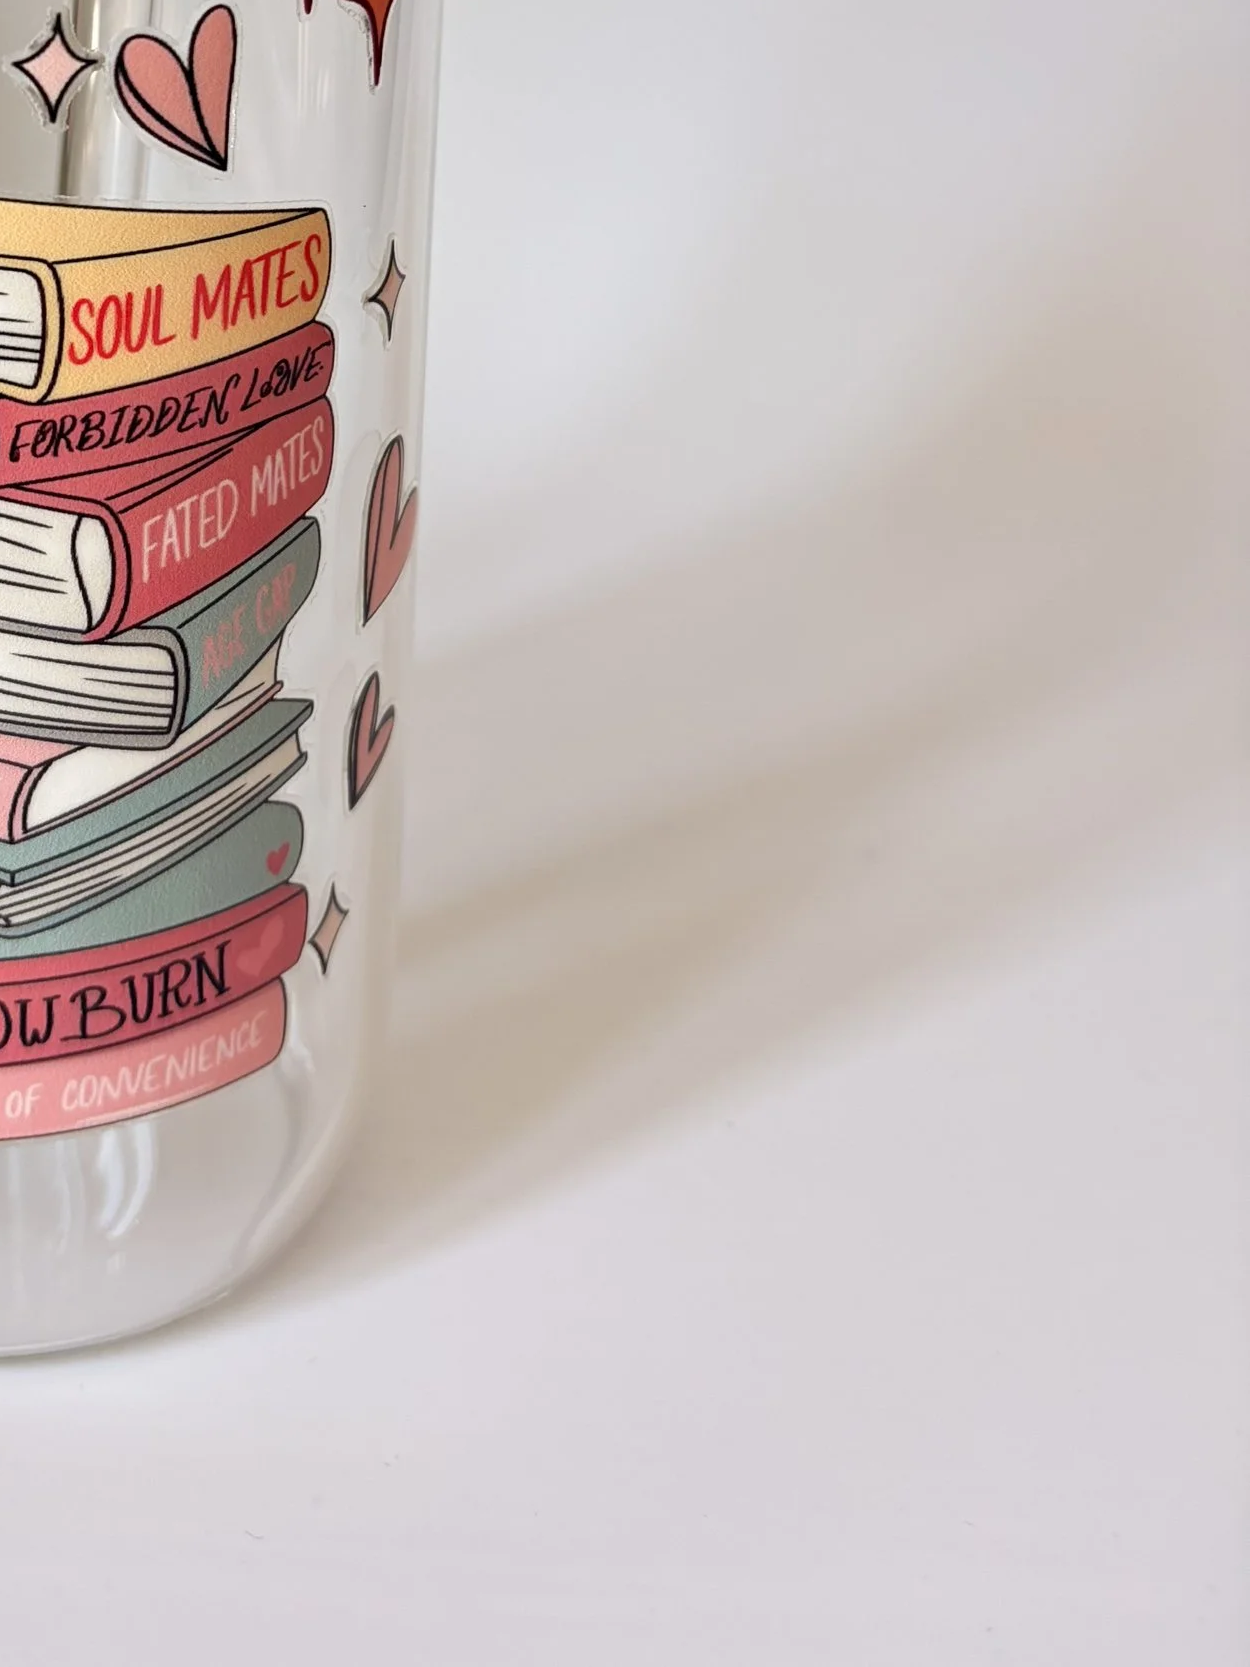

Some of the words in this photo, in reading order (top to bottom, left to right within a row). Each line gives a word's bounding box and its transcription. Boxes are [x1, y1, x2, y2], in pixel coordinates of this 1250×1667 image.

[67, 283, 177, 365] SOUL
[190, 233, 322, 339] MATES
[9, 371, 240, 463] FORBIDDEN
[141, 478, 240, 584] FATED
[251, 415, 325, 516] MATES
[60, 940, 232, 1042] BURN
[4, 1082, 41, 1119] OF
[61, 1010, 268, 1113] CONVENIENCE
